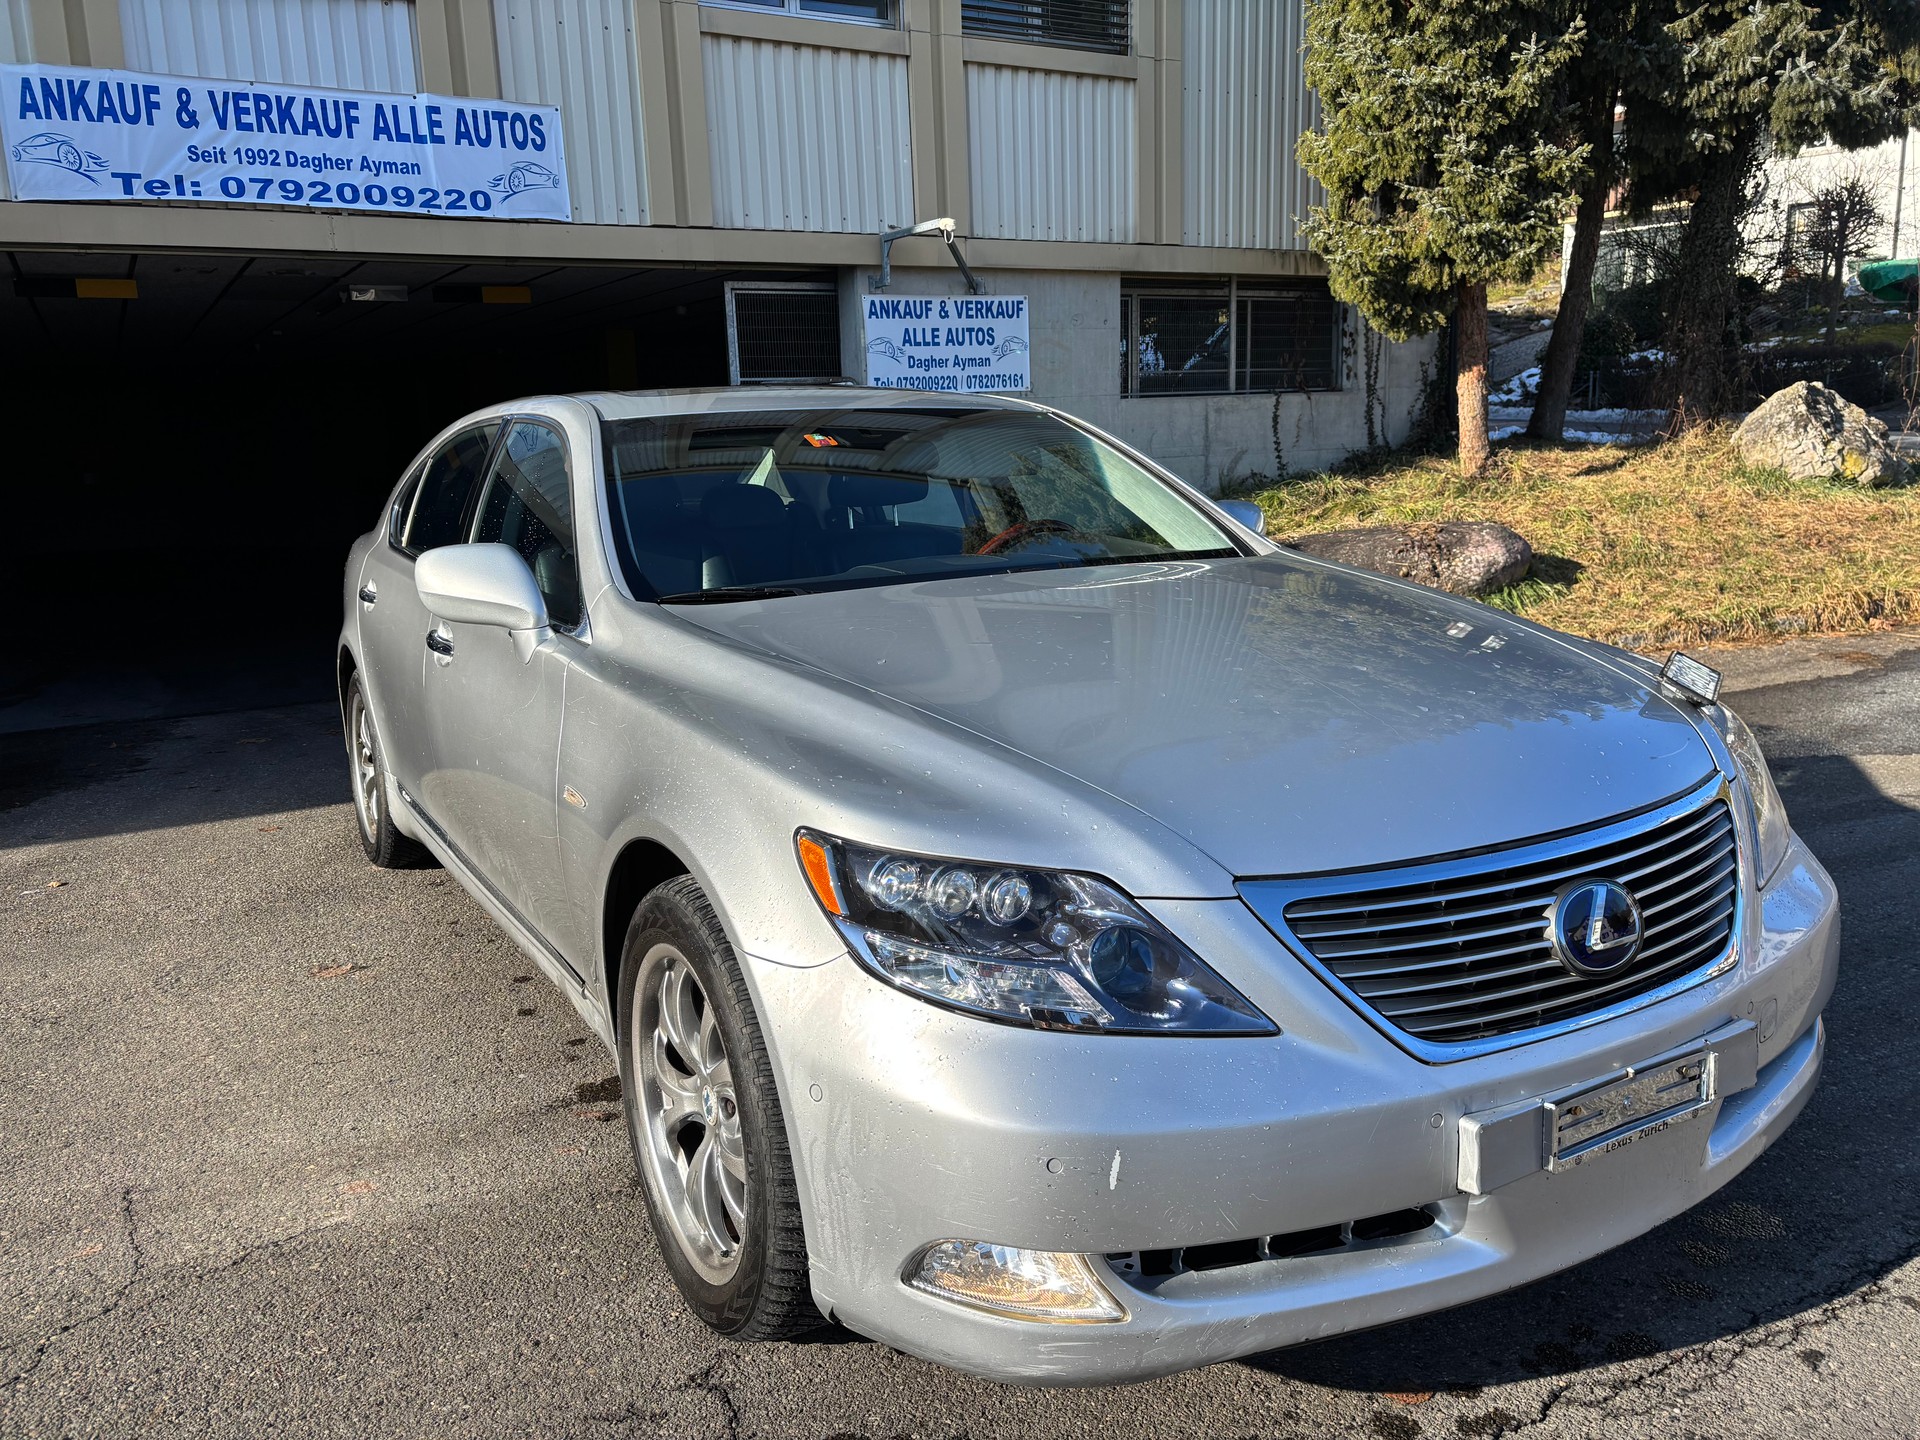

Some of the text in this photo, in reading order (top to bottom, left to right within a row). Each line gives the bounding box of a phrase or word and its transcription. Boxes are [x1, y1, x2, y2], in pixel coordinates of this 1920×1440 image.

[19, 77, 547, 152] ANKAUF & VERKAUF ALLE AUTOS
[187, 144, 422, 177] Seit 1992 Dagher Ayman
[110, 171, 492, 212] Tel: 0792009220
[868, 299, 1024, 320] ANKAUF & VERKAUF
[902, 326, 996, 347] ALLE AUTOS
[907, 354, 991, 372] Dagher Ayman
[896, 374, 958, 391] 0792009220
[966, 373, 1024, 389] 0782076161
[1605, 1134, 1633, 1154] Lexus
